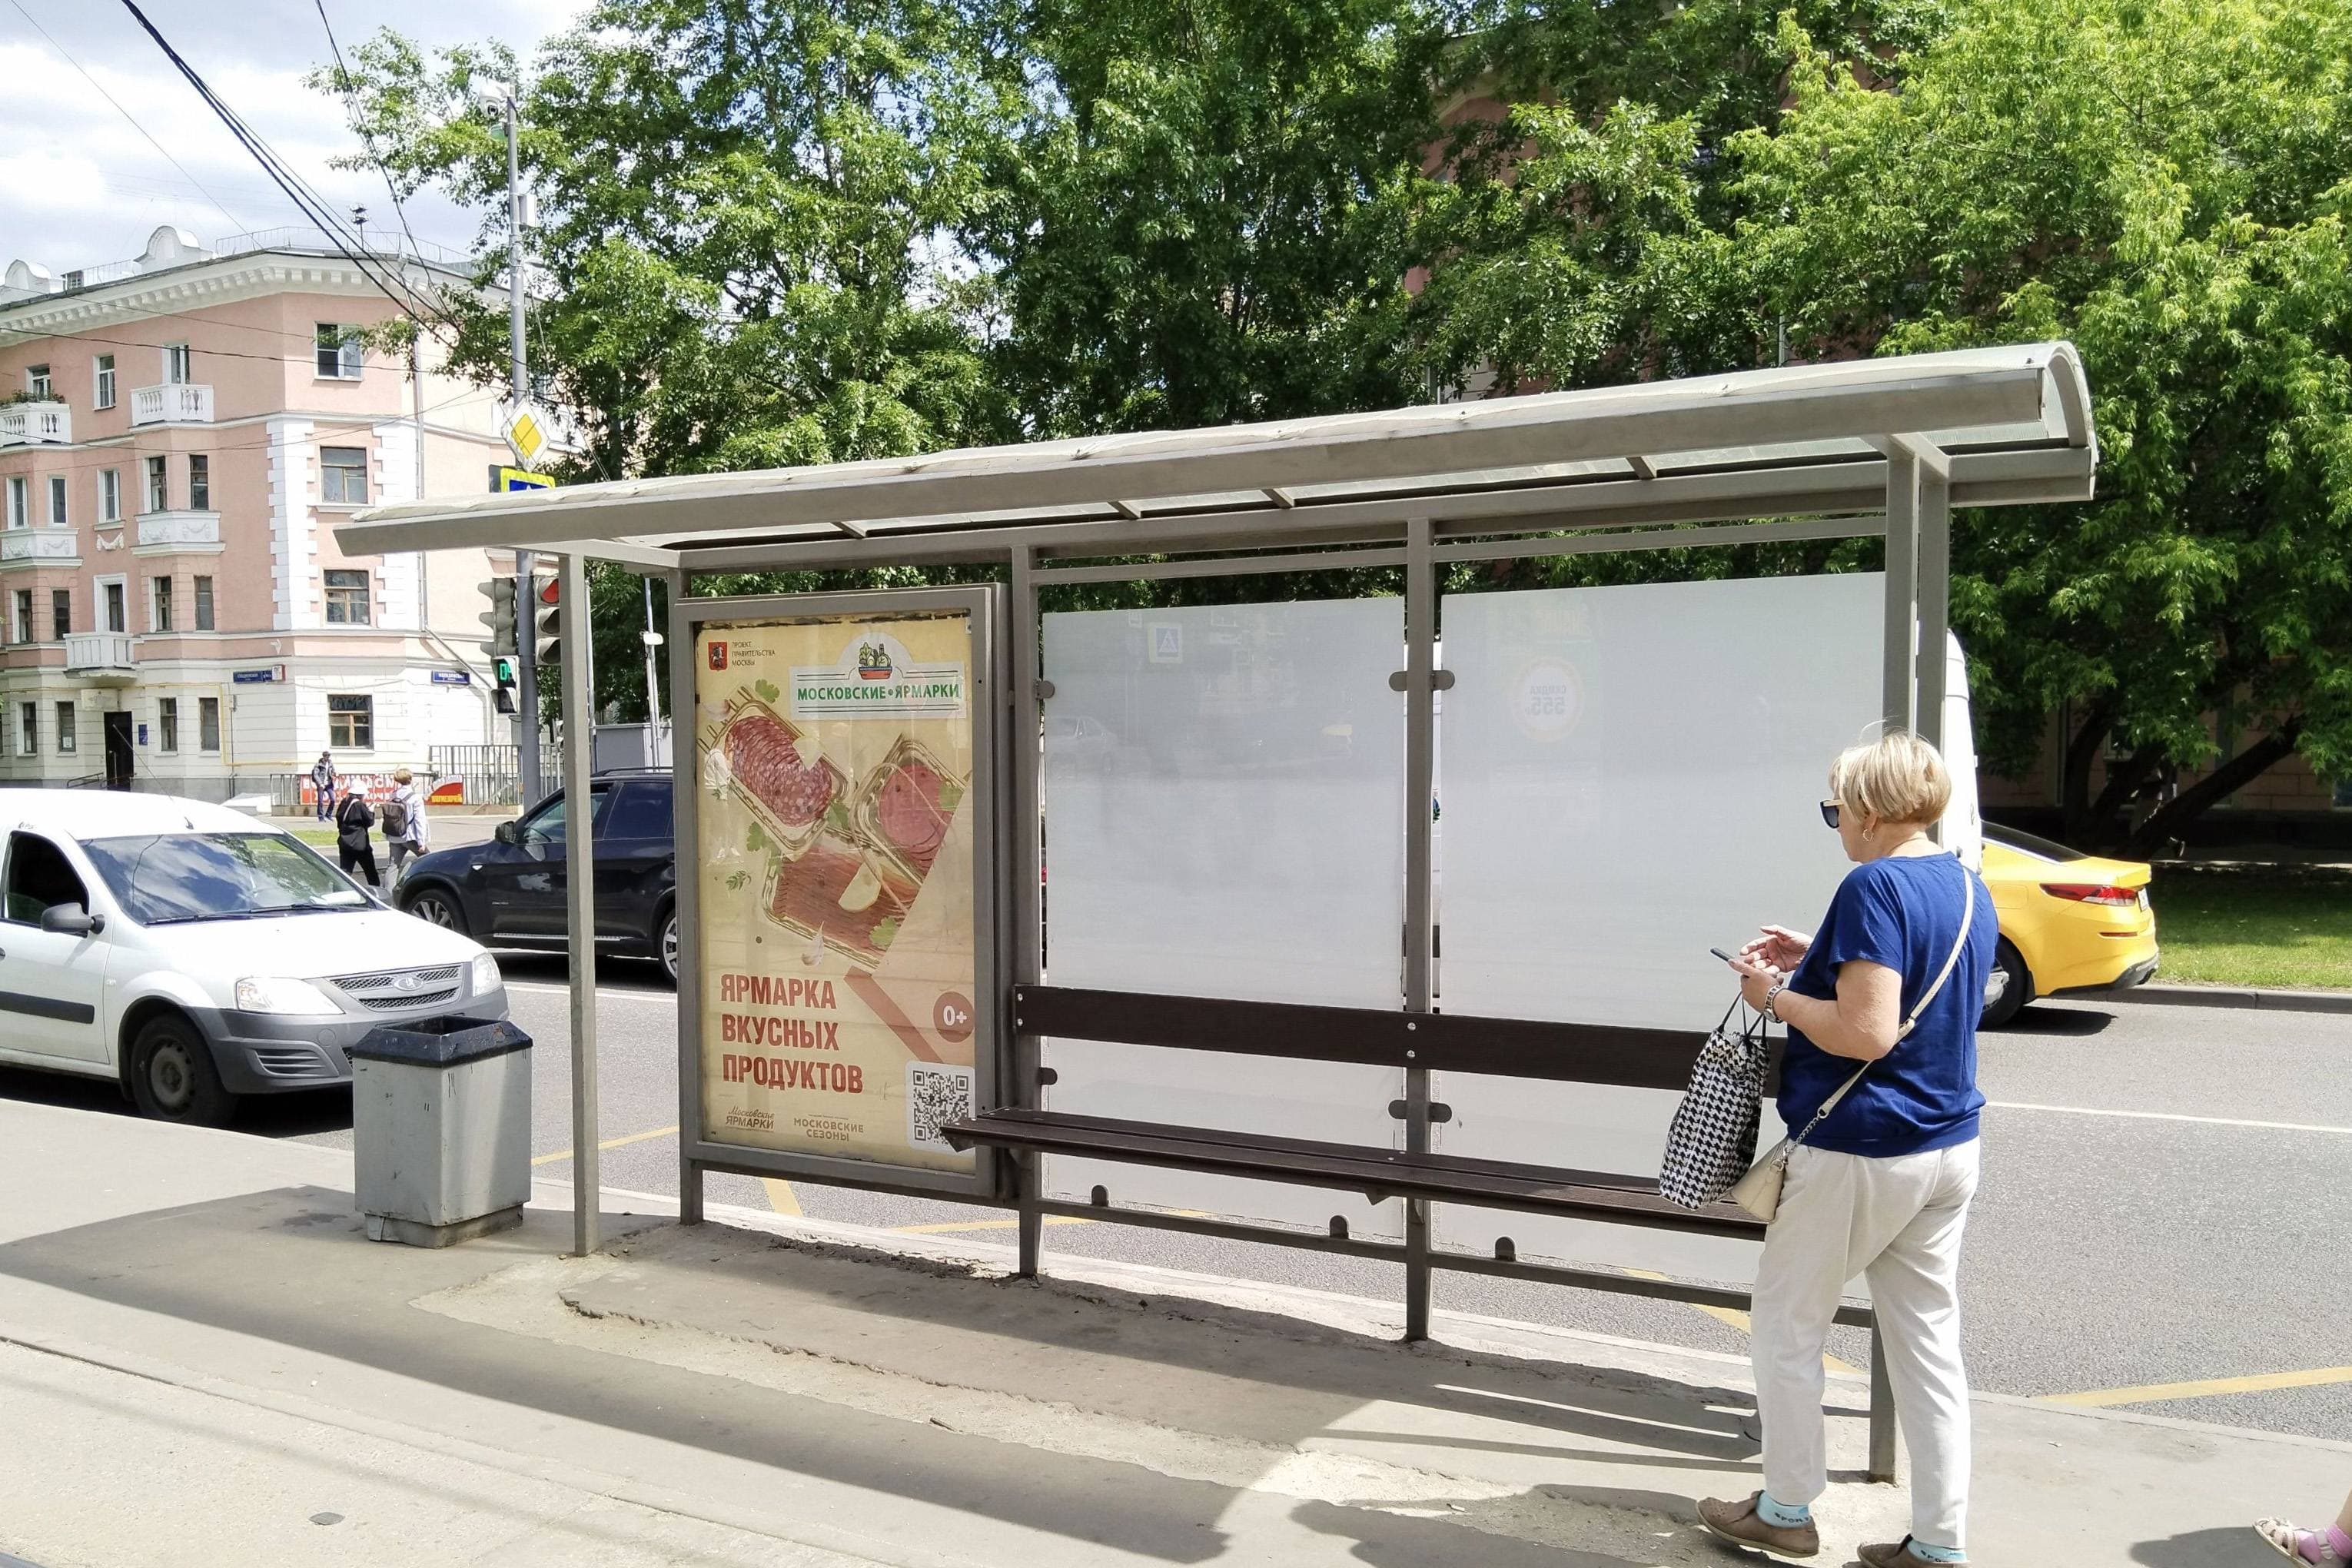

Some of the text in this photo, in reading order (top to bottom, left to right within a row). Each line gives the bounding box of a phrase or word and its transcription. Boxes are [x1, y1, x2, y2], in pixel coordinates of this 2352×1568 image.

[732, 649, 776, 657] ПРАВИТЕЛЬСТВА
[797, 683, 960, 701] МОСКОВСКИЕ ЯРМАРКИ
[720, 973, 837, 1009] ЯРМАРКА
[942, 1005, 967, 1026] 0+
[721, 1014, 839, 1051] ВКУСНЫХ
[723, 1054, 863, 1094] ПРОДУКТОВ
[728, 1105, 775, 1119] Московские
[725, 1115, 774, 1129] ЯРМАРКИ
[793, 1118, 864, 1133] МОСКОВСКИЕ
[806, 1129, 849, 1141] СЕЗОНЫ
